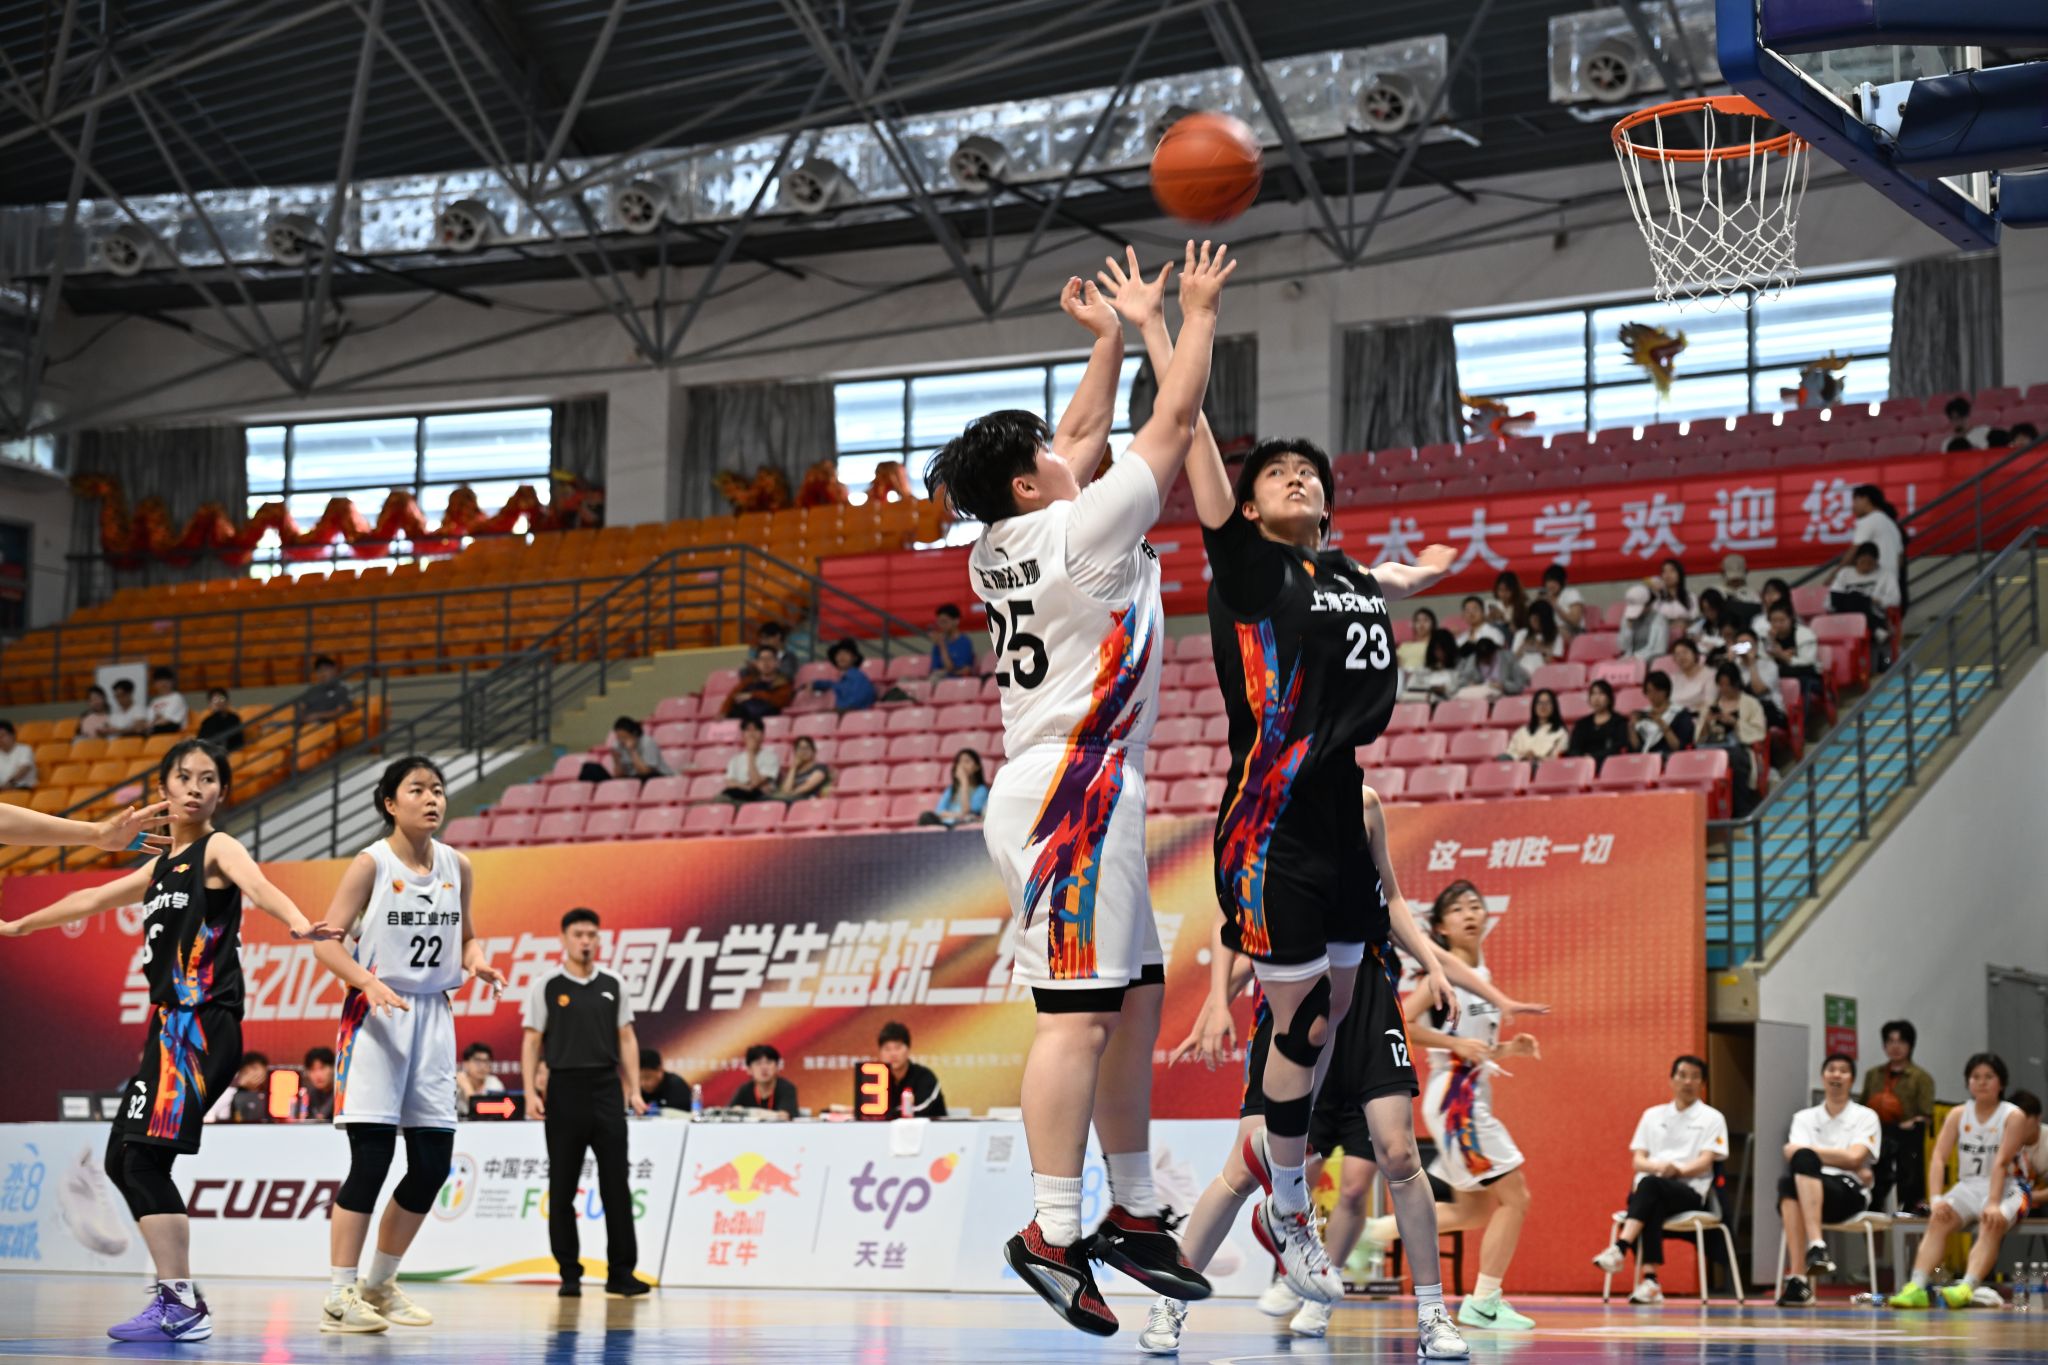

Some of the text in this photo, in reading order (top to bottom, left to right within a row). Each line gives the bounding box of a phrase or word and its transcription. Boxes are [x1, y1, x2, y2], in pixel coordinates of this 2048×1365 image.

[985, 600, 1049, 689] 25
[1345, 621, 1391, 671] 23
[1427, 834, 1615, 872] 这一刻胜一切
[387, 911, 461, 926] 合肥工业大学
[410, 935, 443, 968] 22
[1390, 1042, 1411, 1067] 12
[861, 1062, 890, 1115] 3
[127, 1094, 147, 1119] 32
[1972, 1158, 1984, 1176] 7
[187, 1179, 342, 1219] CUBA
[521, 1188, 648, 1220] FUS
[708, 1239, 759, 1266] 红牛
[853, 1241, 907, 1269] 天丝
